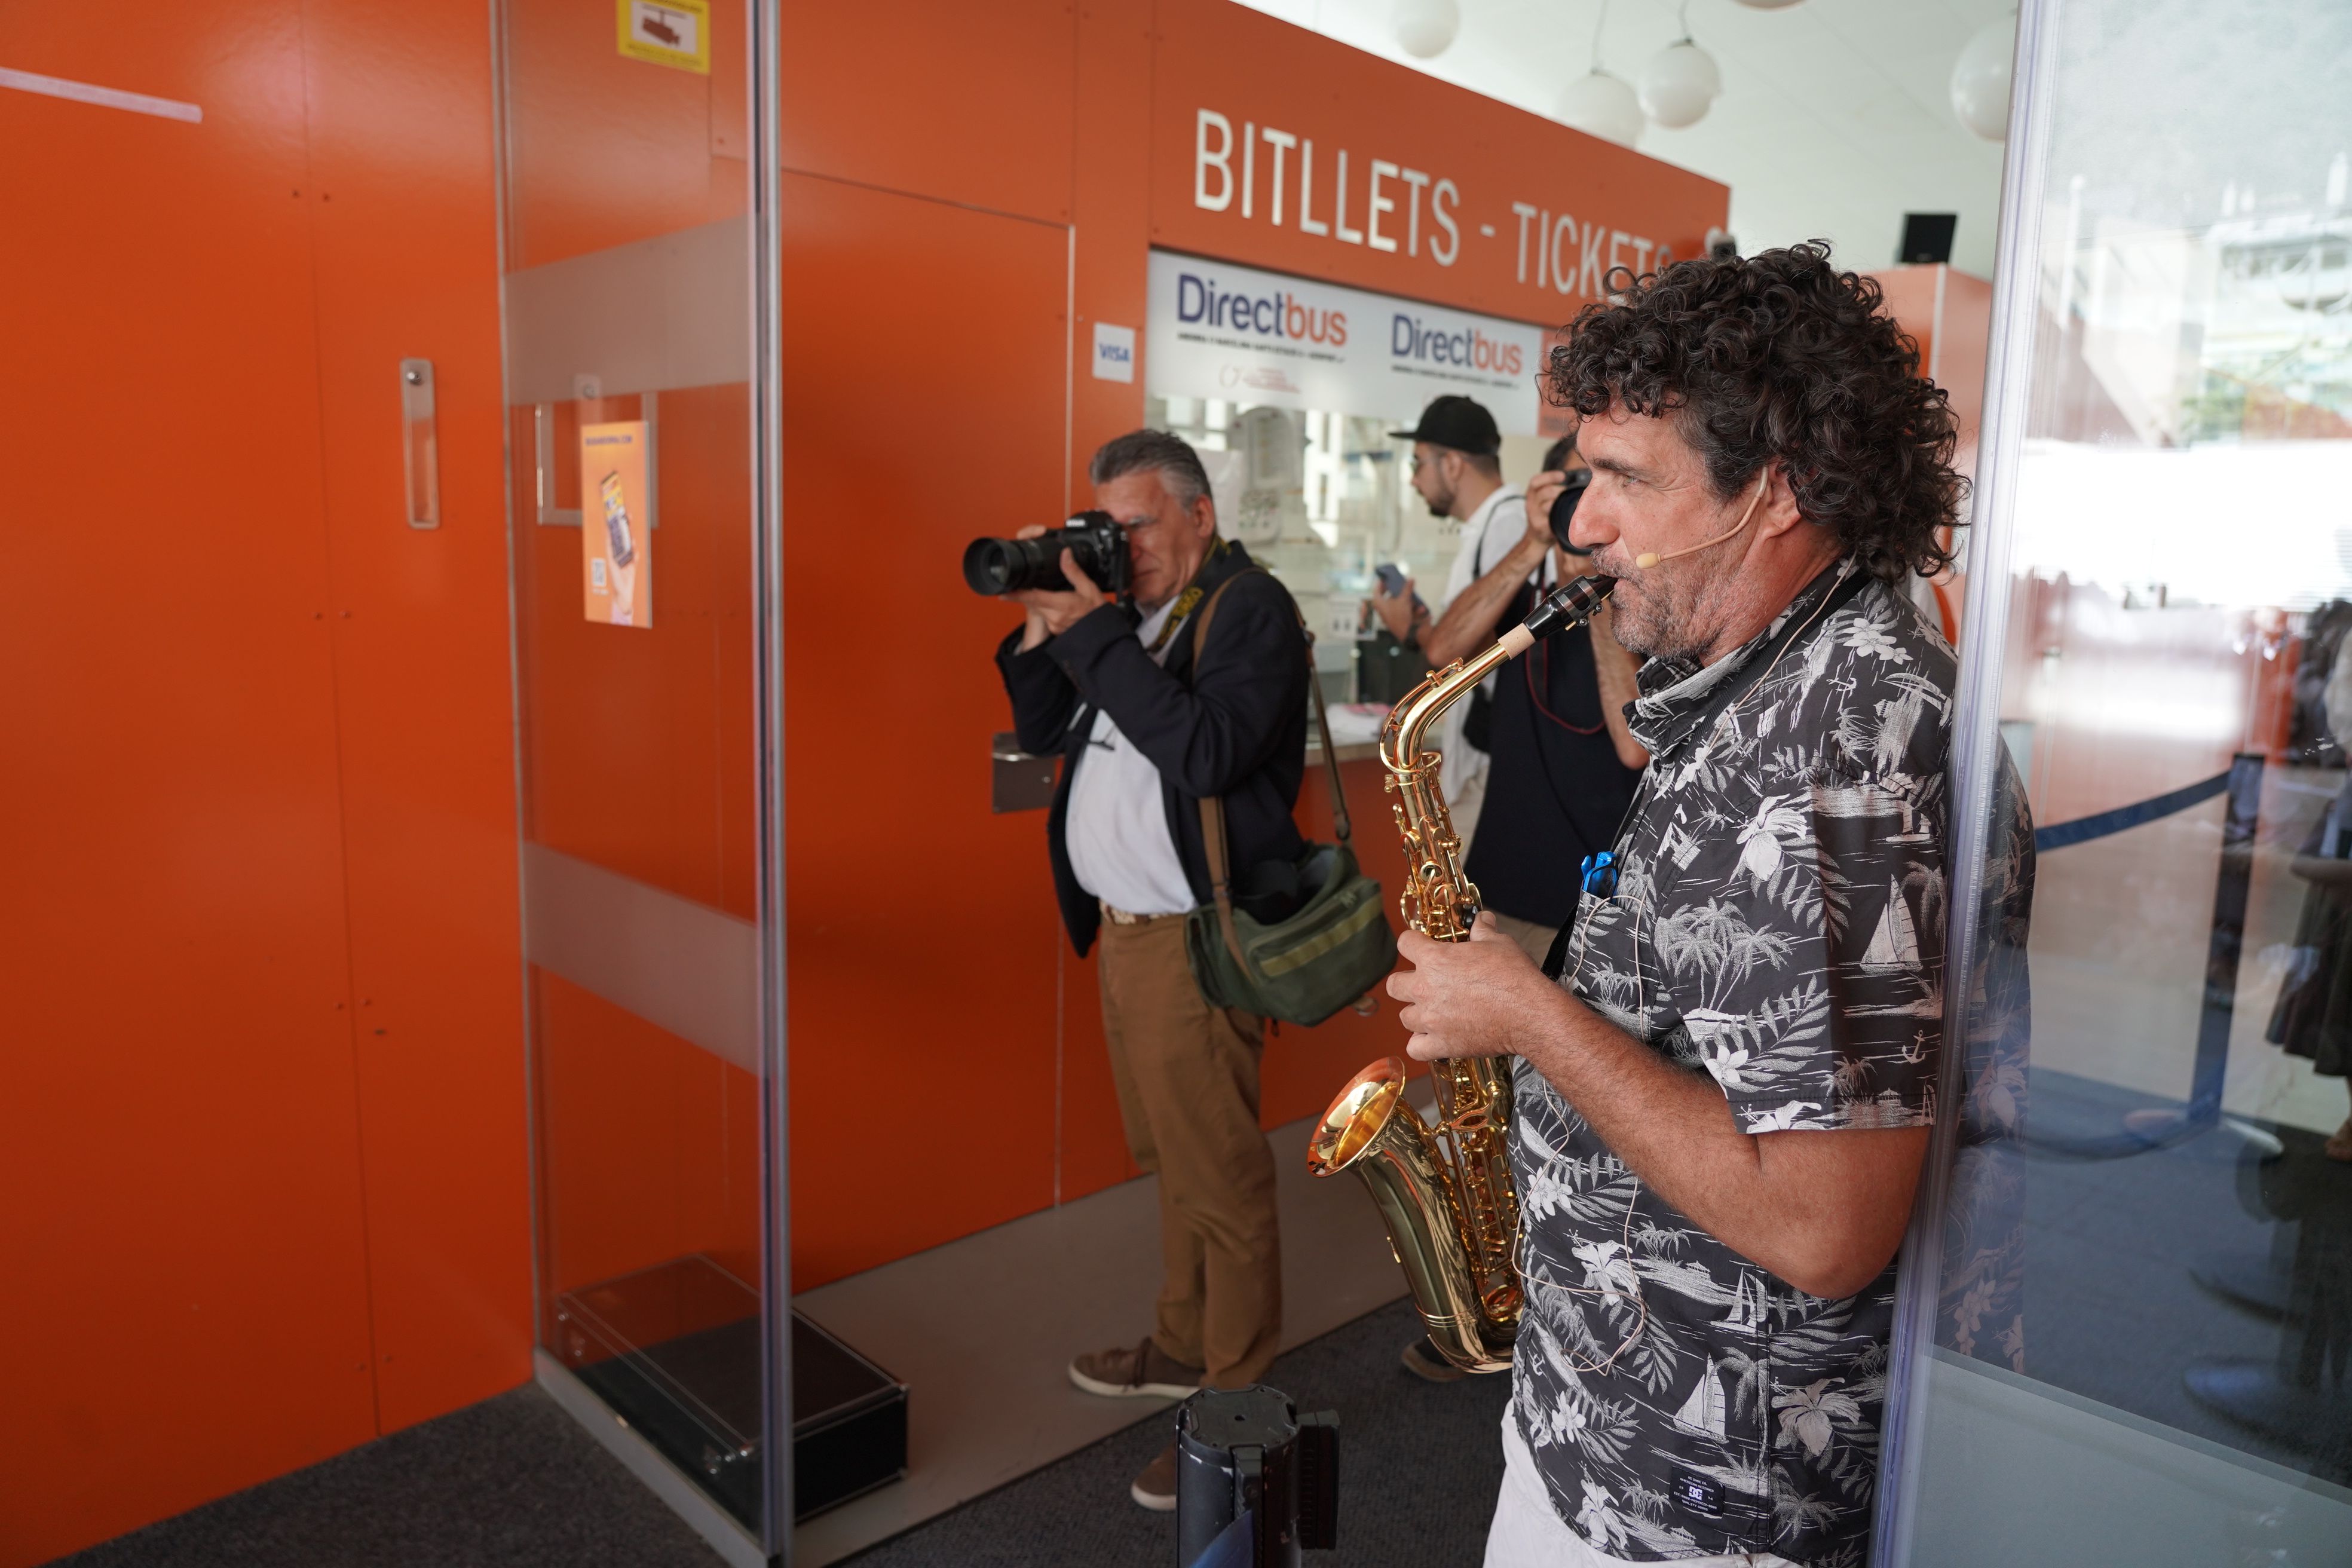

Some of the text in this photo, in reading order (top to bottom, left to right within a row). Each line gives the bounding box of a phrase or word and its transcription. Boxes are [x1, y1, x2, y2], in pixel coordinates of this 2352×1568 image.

[1196, 108, 1460, 267] BITLLETS
[1177, 273, 1348, 347] Directbus
[1392, 314, 1523, 376] Directbus
